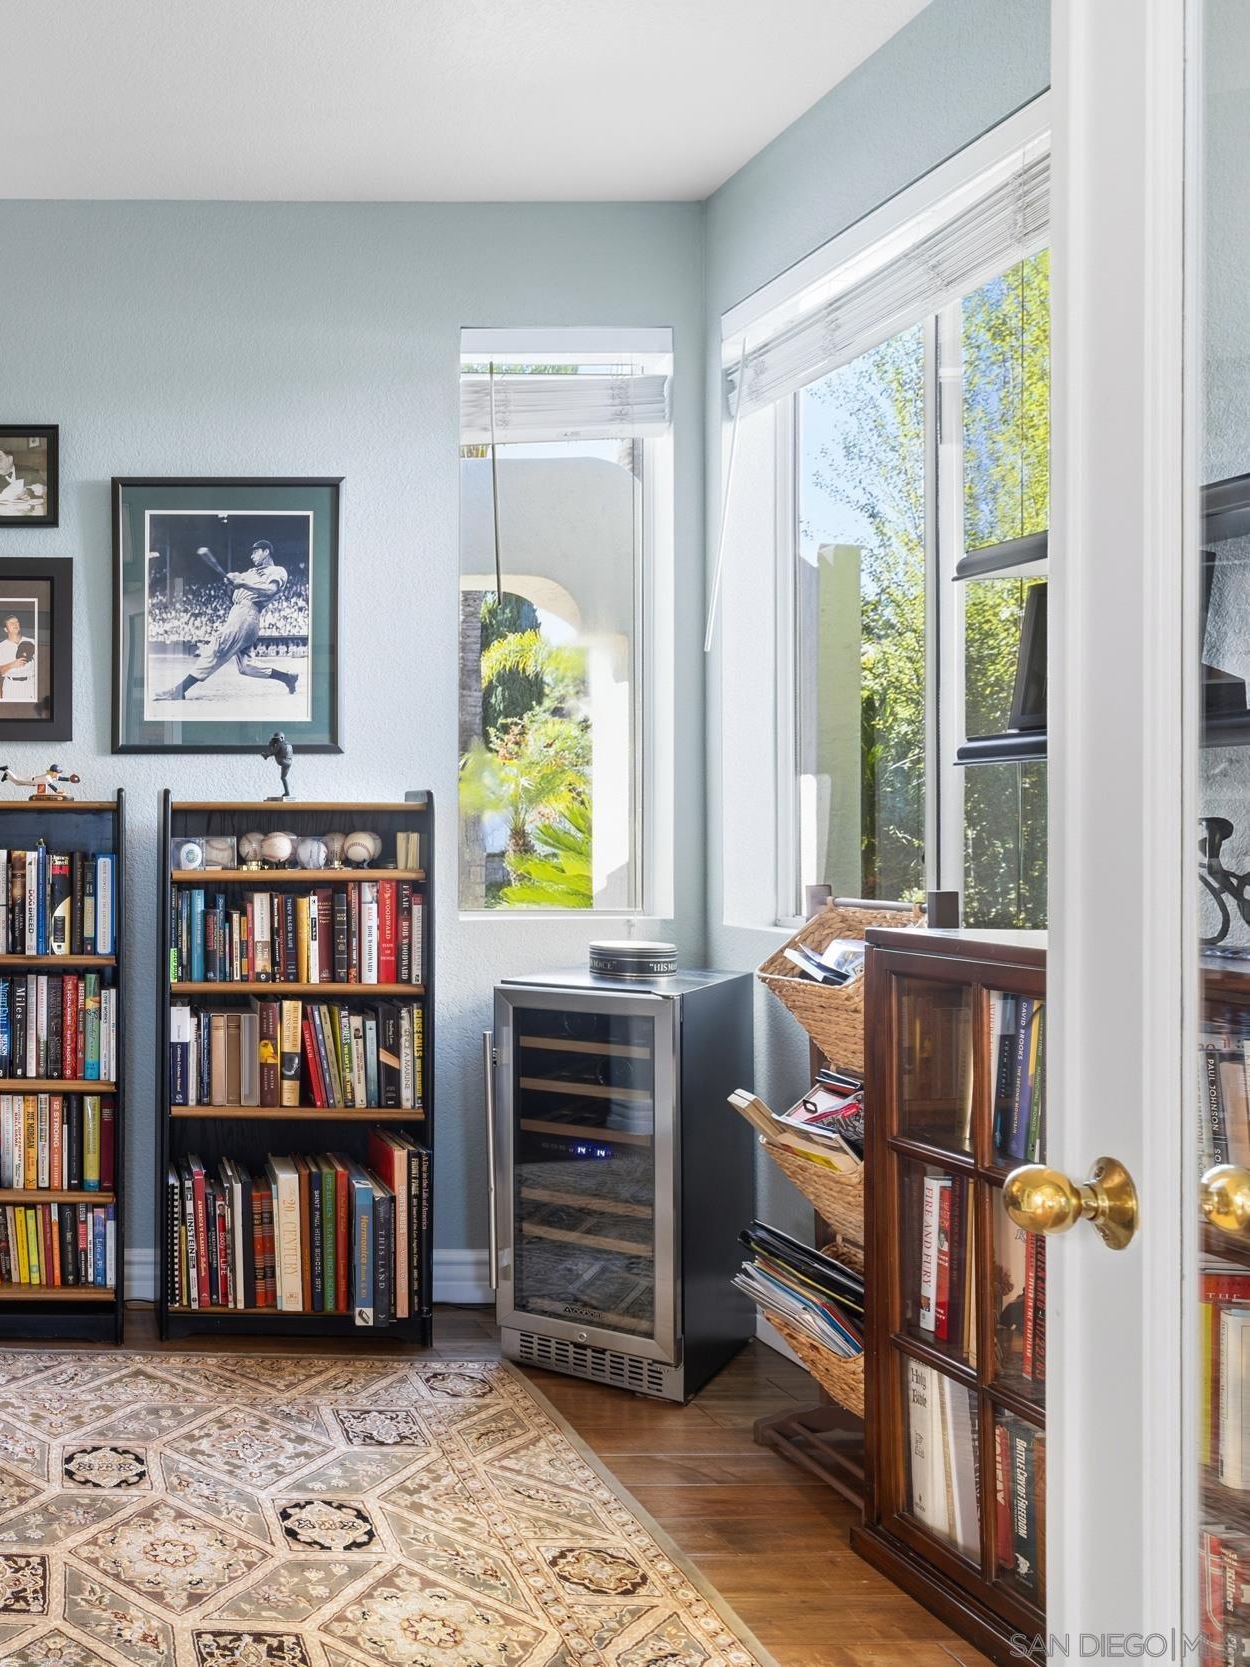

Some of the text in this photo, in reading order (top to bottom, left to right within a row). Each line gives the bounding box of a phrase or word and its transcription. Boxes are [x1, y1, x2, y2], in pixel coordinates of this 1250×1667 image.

[16, 987, 25, 1019] Miles
[341, 1018, 350, 1044] MICHAELS
[414, 1009, 422, 1032] CLOSE
[304, 1030, 312, 1058] IMPEACH
[414, 1034, 422, 1057] CALLS
[1033, 1066, 1041, 1102] MUNICIPAL
[1207, 1059, 1219, 1131] PAUL JOHNSON
[54, 1101, 59, 1110] 12
[187, 1213, 195, 1254] EINSTEIN
[283, 1199, 298, 1277] 20 CENTURY
[360, 1215, 368, 1263] Harmonica
[922, 1187, 933, 1287] FIRE AND FURY
[96, 1261, 102, 1269] Pi
[1037, 1281, 1045, 1309] KING
[1015, 1438, 1028, 1539] BATTLE CRY OF FREEDOM
[1227, 1569, 1235, 1612] Killers
